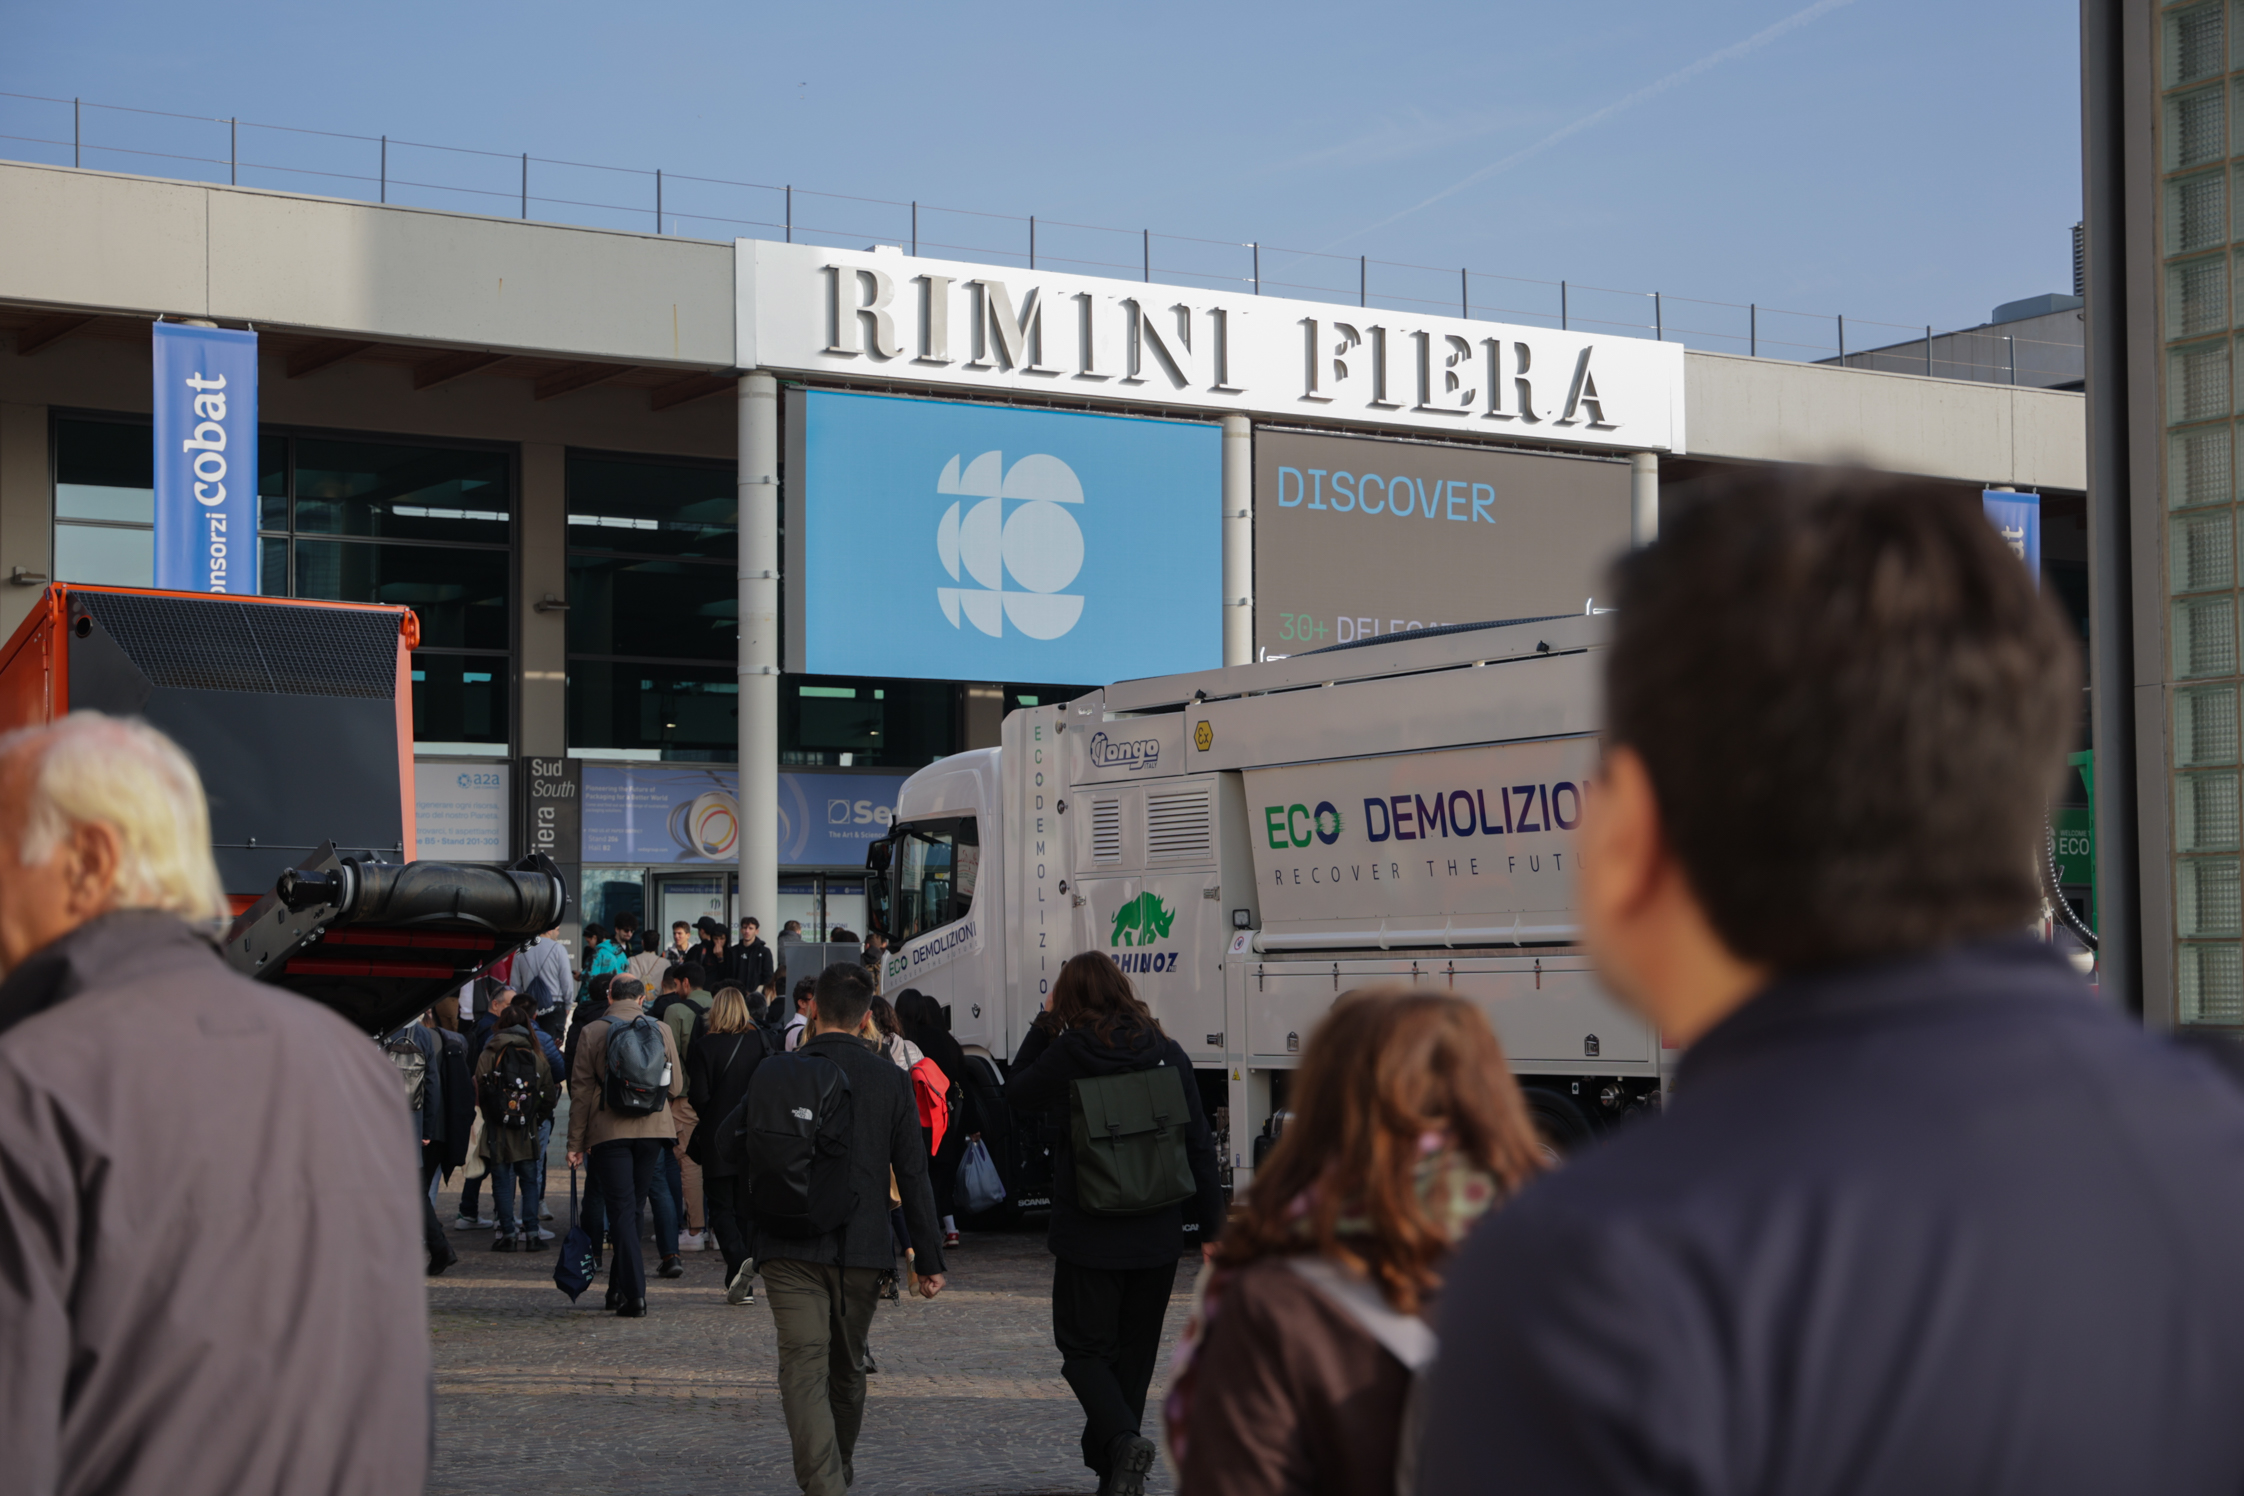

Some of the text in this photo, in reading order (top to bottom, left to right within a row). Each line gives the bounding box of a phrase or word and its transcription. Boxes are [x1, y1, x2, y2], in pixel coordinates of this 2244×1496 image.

[825, 263, 1624, 429] RIMINI FIERA
[183, 371, 227, 507] cobat
[1278, 465, 1497, 524] DISCOVER
[1279, 613, 1329, 642] 30+
[1093, 735, 1160, 770] Longo
[532, 759, 562, 777] Sud
[1143, 761, 1158, 770] ITALY
[473, 773, 500, 785] a2a
[532, 779, 575, 798] South
[416, 802, 454, 810] rigenerare
[455, 802, 472, 810] ogni
[432, 811, 444, 819] del
[853, 799, 897, 824] Se
[455, 828, 499, 836] aspettiamo!
[537, 806, 555, 861] iera
[1265, 800, 1346, 850] ECO
[424, 837, 436, 845] B5
[441, 837, 465, 845] Stand
[466, 837, 500, 846] 201-300
[588, 835, 607, 843] Stand
[829, 831, 841, 839] The
[842, 831, 854, 839] Art
[860, 831, 886, 839] Science
[588, 844, 602, 852] Hall
[2059, 837, 2090, 856] ECO
[1274, 862, 1401, 886] RECOVER
[1426, 857, 1479, 878] THE
[888, 920, 977, 977] ECO DEMOLIZIONI
[927, 956, 942, 970] THE
[1017, 1197, 1051, 1207] SCANIA
